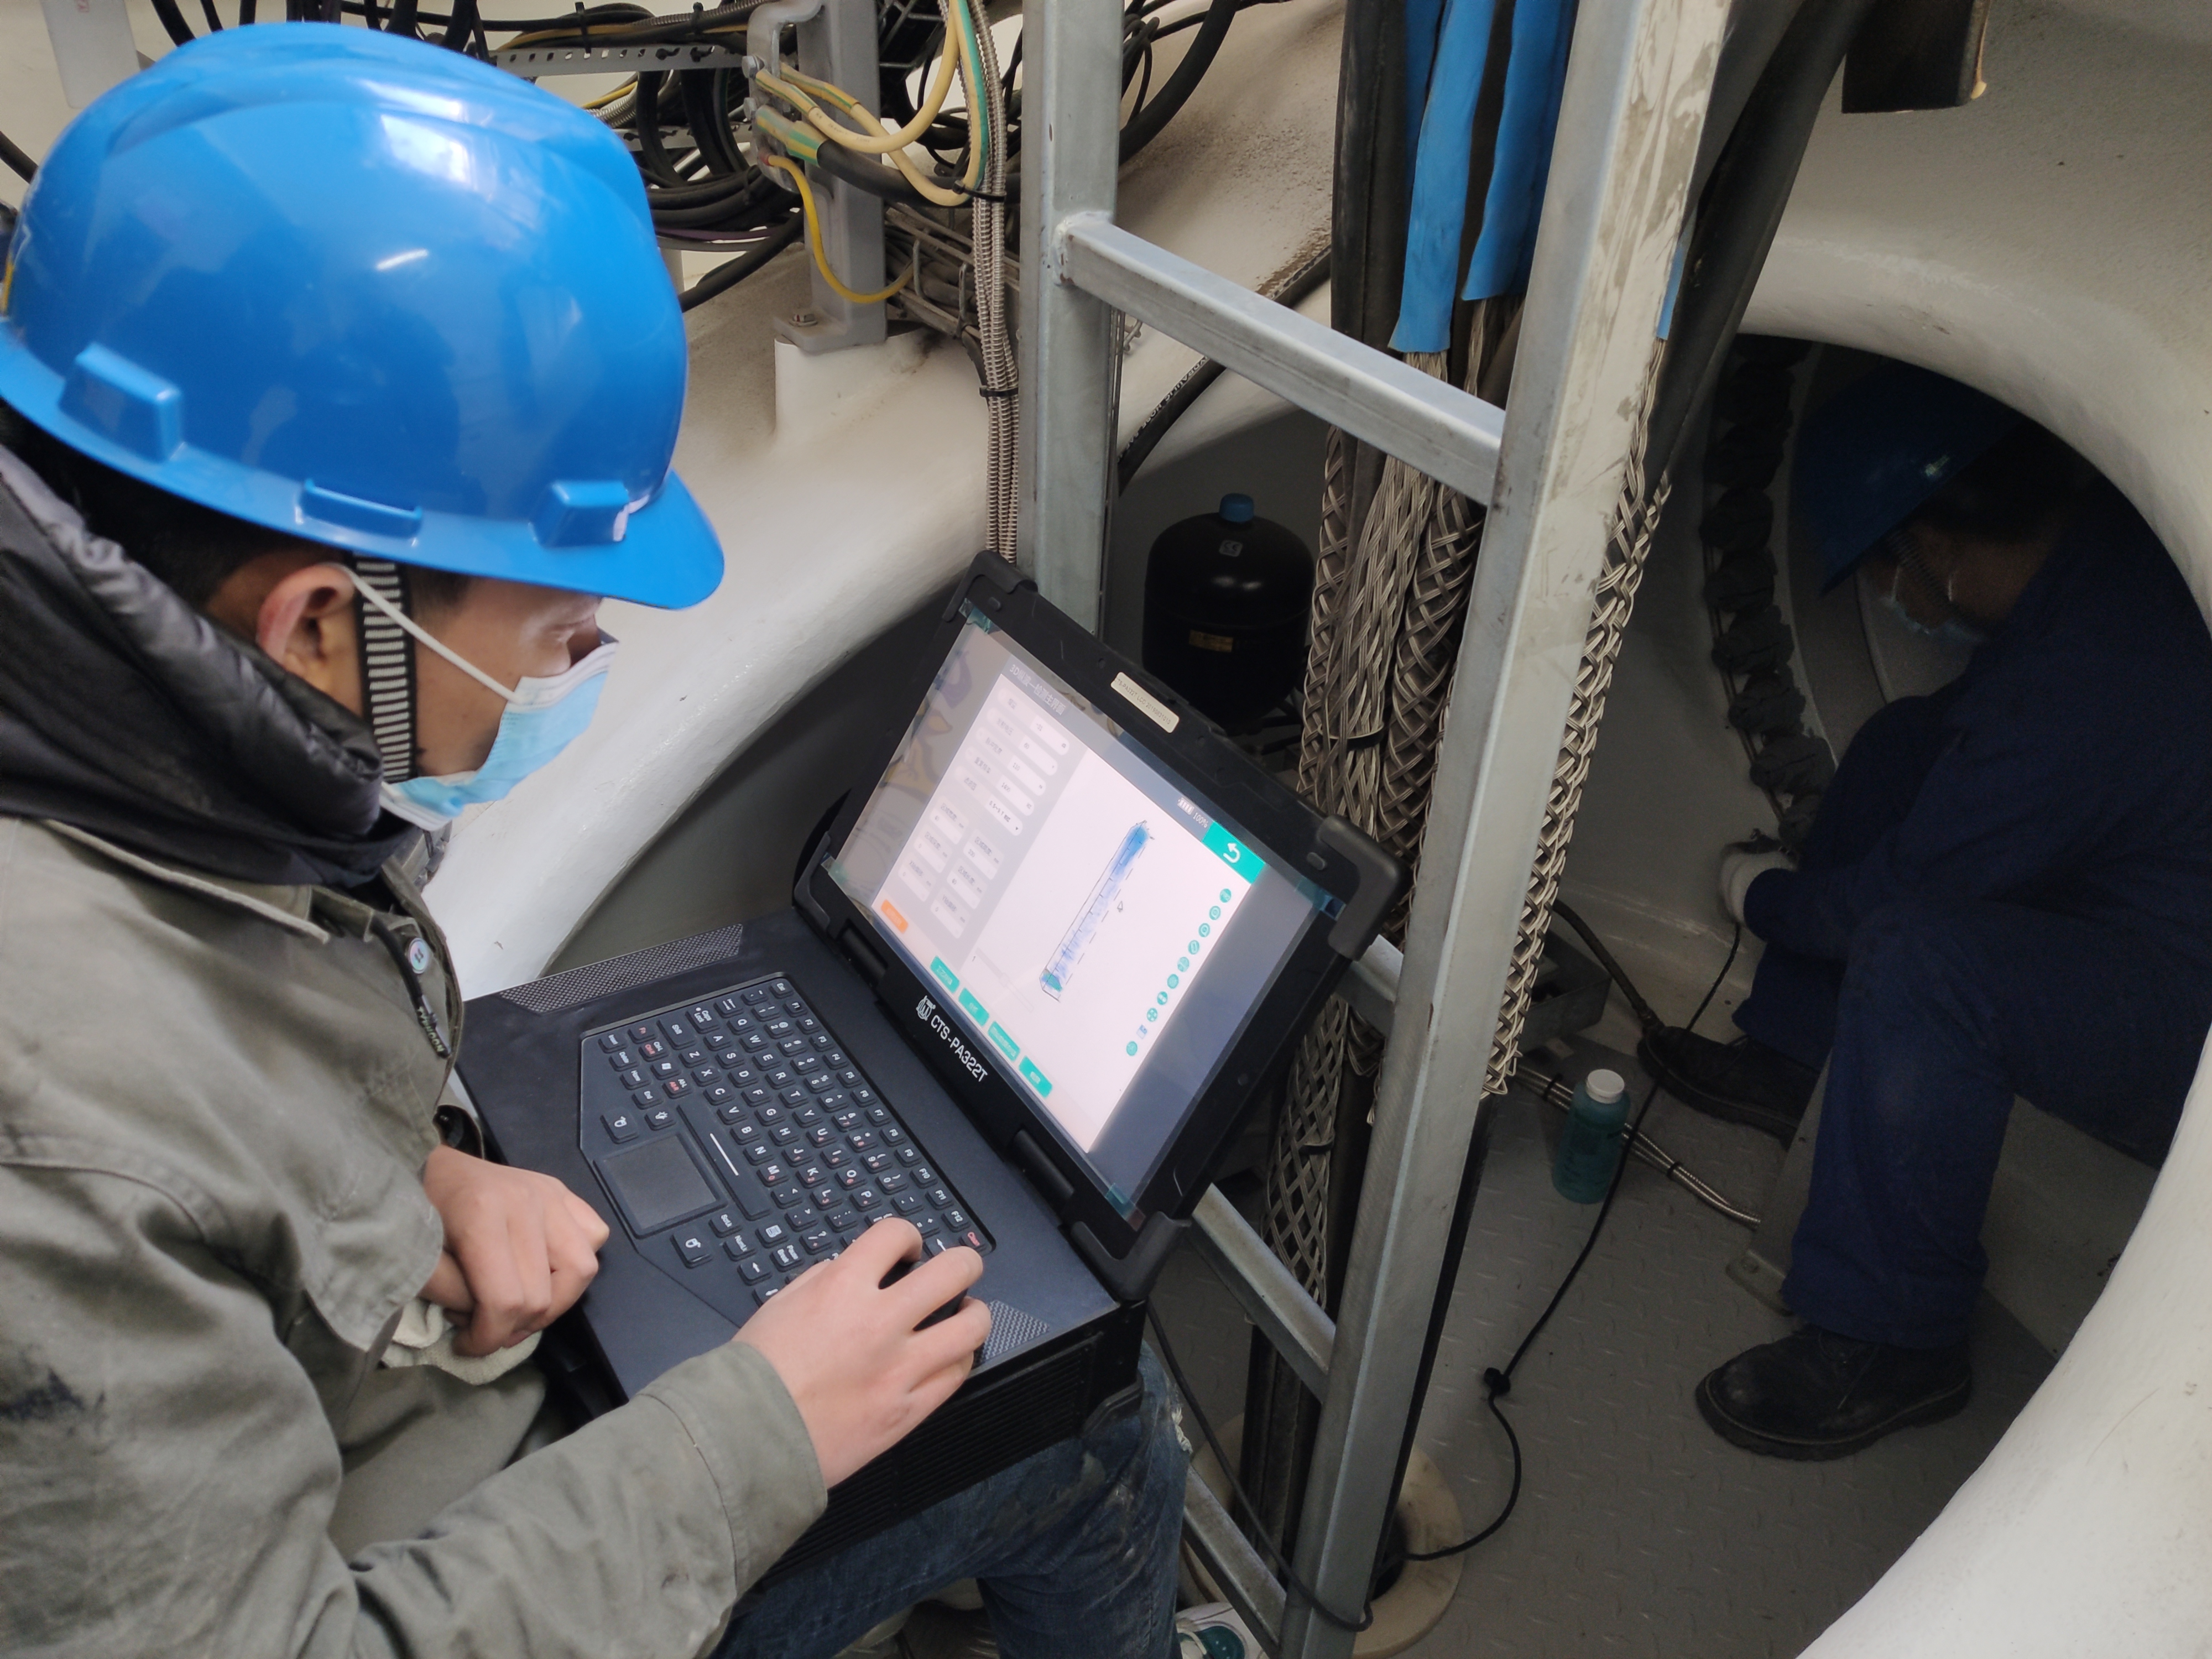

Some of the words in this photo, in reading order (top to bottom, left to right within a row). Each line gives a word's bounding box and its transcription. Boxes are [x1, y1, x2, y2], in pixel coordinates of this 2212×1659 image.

[1193, 812, 1208, 828] 100%
[749, 1035, 761, 1043] W
[931, 1015, 988, 1082] CTS-PA322T
[779, 1128, 791, 1136] H
[755, 1146, 766, 1155] N
[905, 1149, 914, 1157] F9
[768, 1165, 780, 1175] M
[807, 1167, 819, 1176] K
[919, 1168, 930, 1179] F10
[822, 1189, 831, 1197] L
[935, 1190, 947, 1200] F11
[951, 1211, 963, 1223] F12
[786, 1245, 799, 1260] Pause
